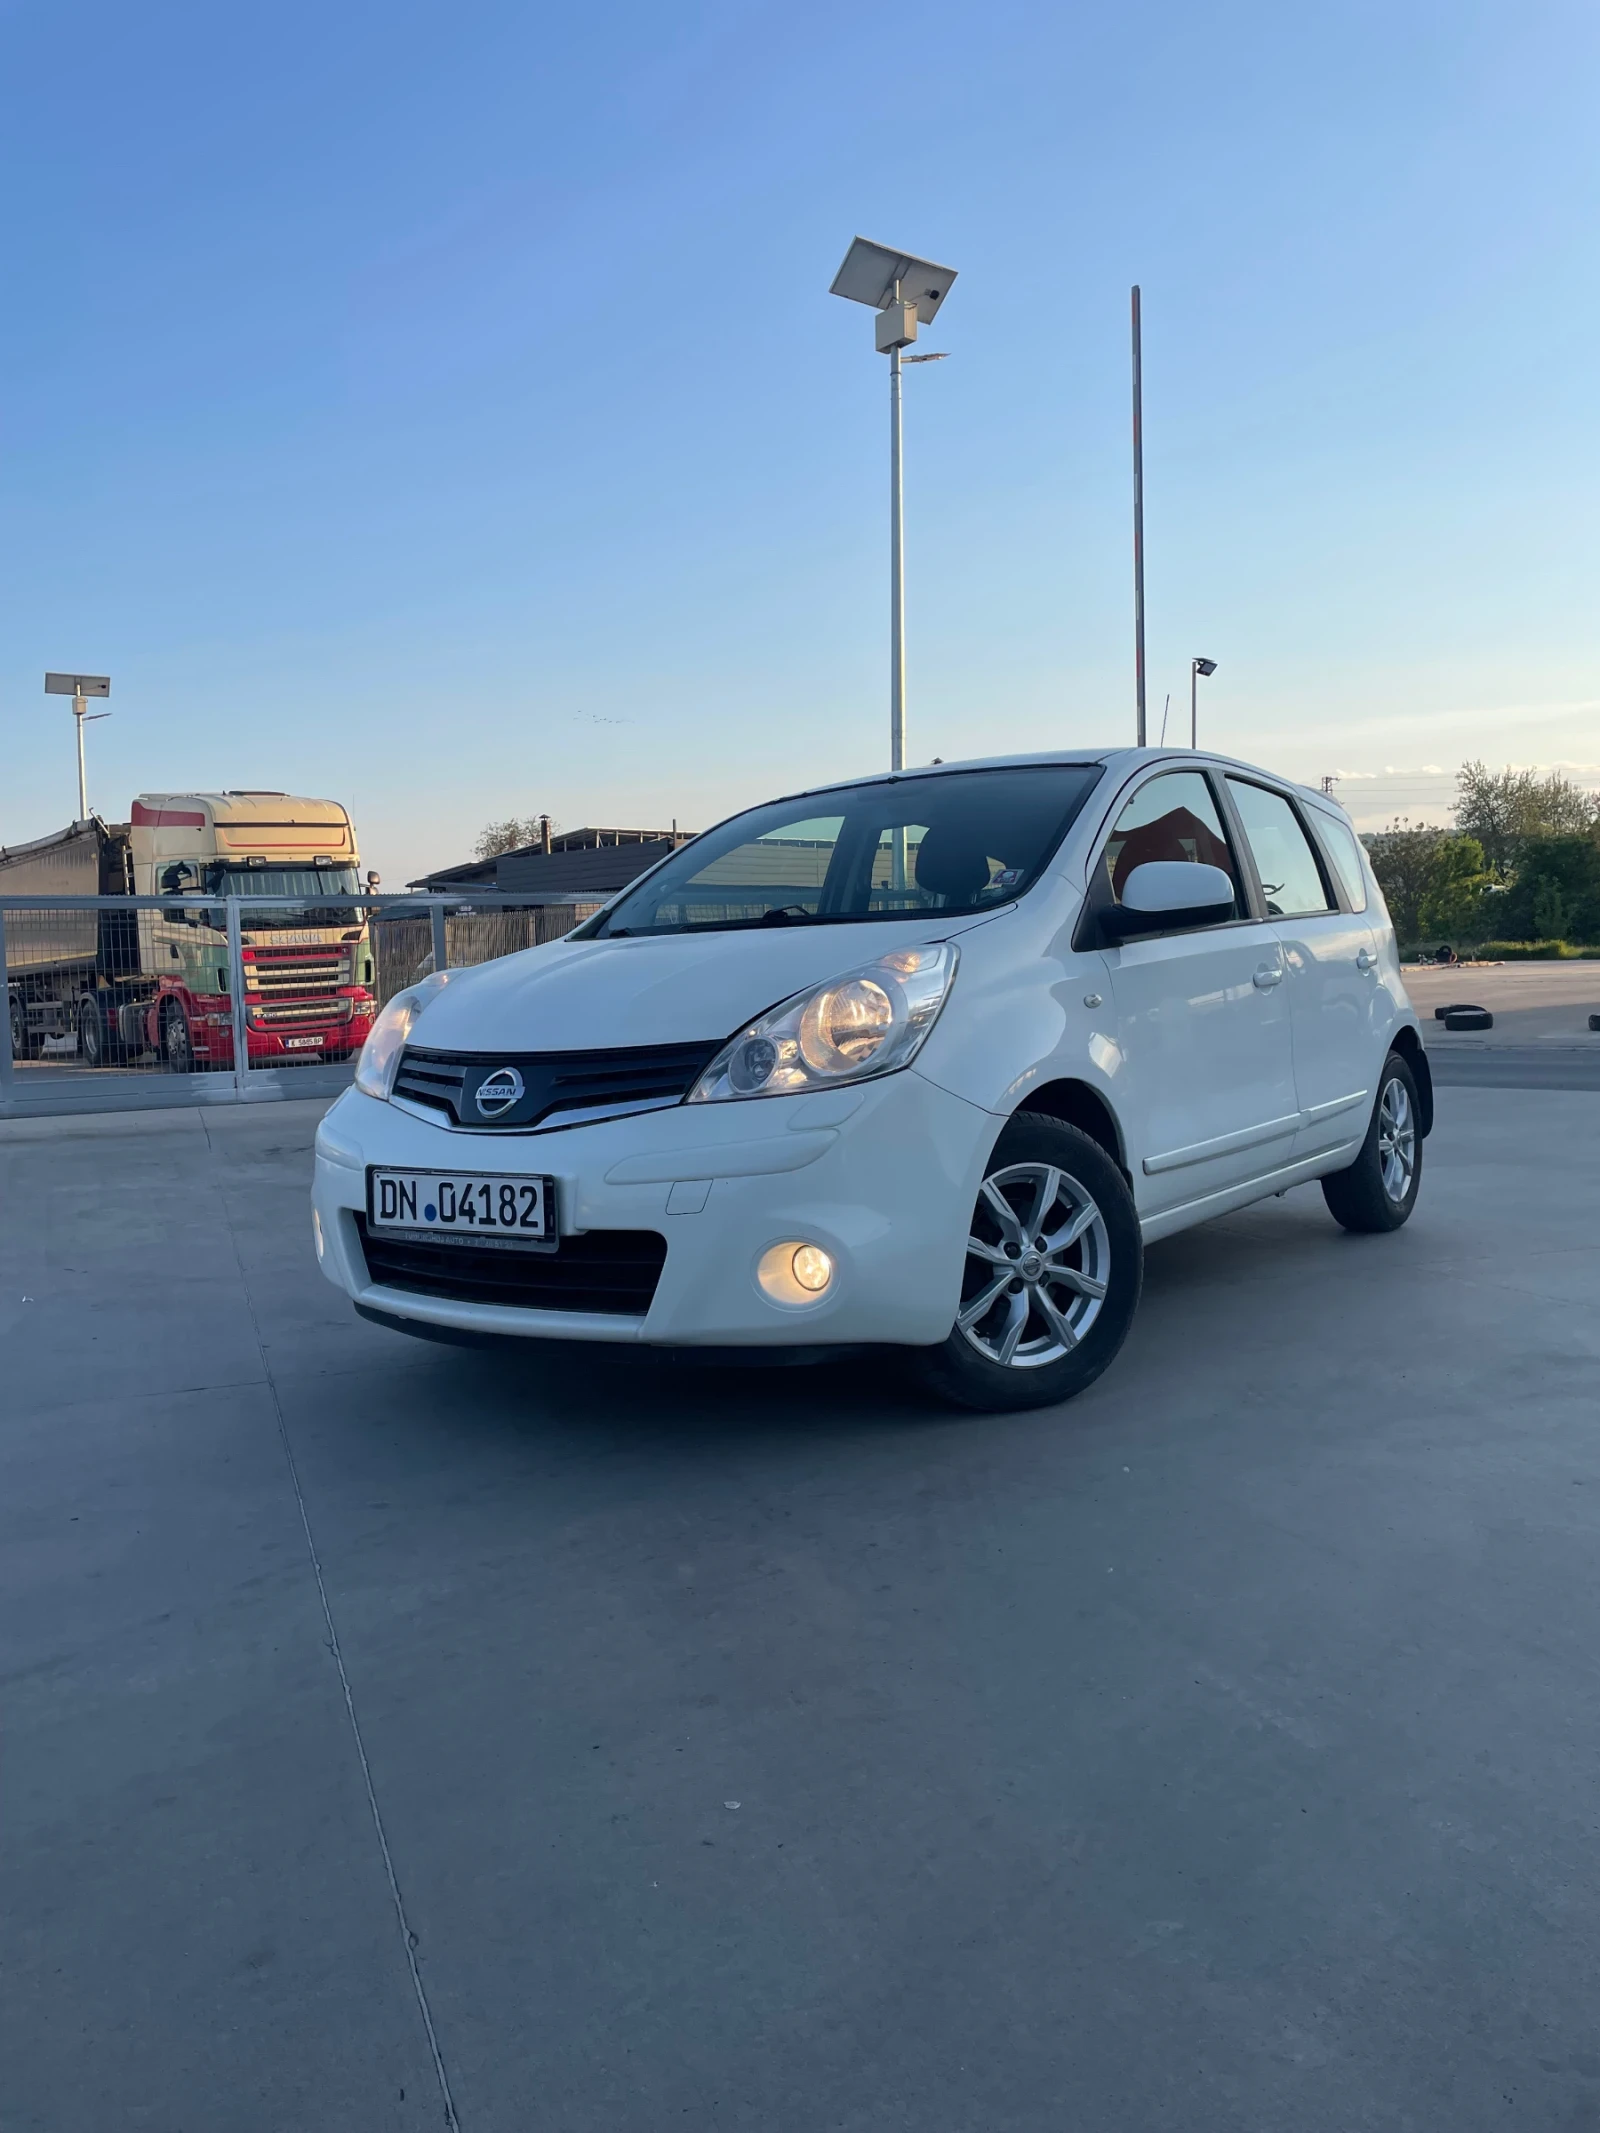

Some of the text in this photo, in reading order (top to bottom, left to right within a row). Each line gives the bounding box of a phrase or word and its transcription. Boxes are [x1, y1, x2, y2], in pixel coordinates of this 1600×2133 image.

[477, 1087, 517, 1097] NISSAN
[380, 1179, 539, 1228] DN 04182
